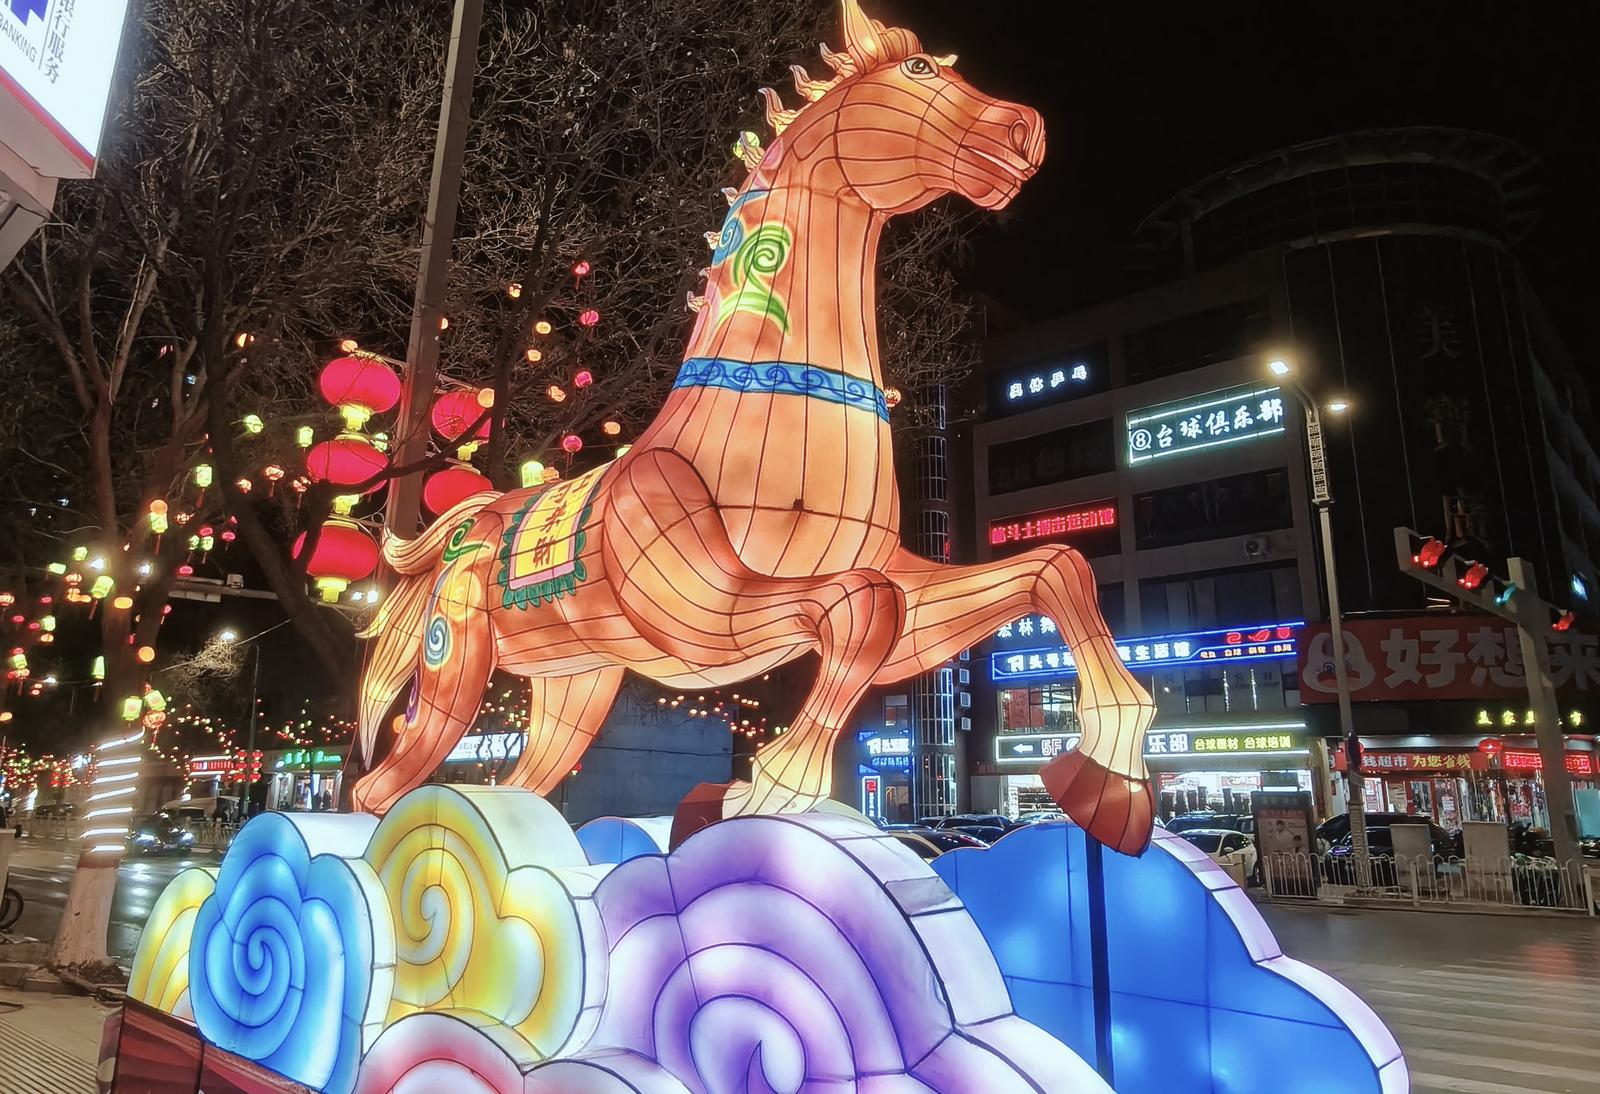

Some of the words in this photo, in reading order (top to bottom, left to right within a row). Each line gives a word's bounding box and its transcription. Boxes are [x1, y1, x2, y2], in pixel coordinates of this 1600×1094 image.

[1156, 397, 1284, 449] 台球俱乐部
[1380, 625, 1600, 690] 好想来
[1040, 738, 1062, 756] 5F
[1194, 737, 1239, 751] 台球器材
[1244, 735, 1292, 750] 台球培训
[1412, 753, 1472, 769] 为您省钱
